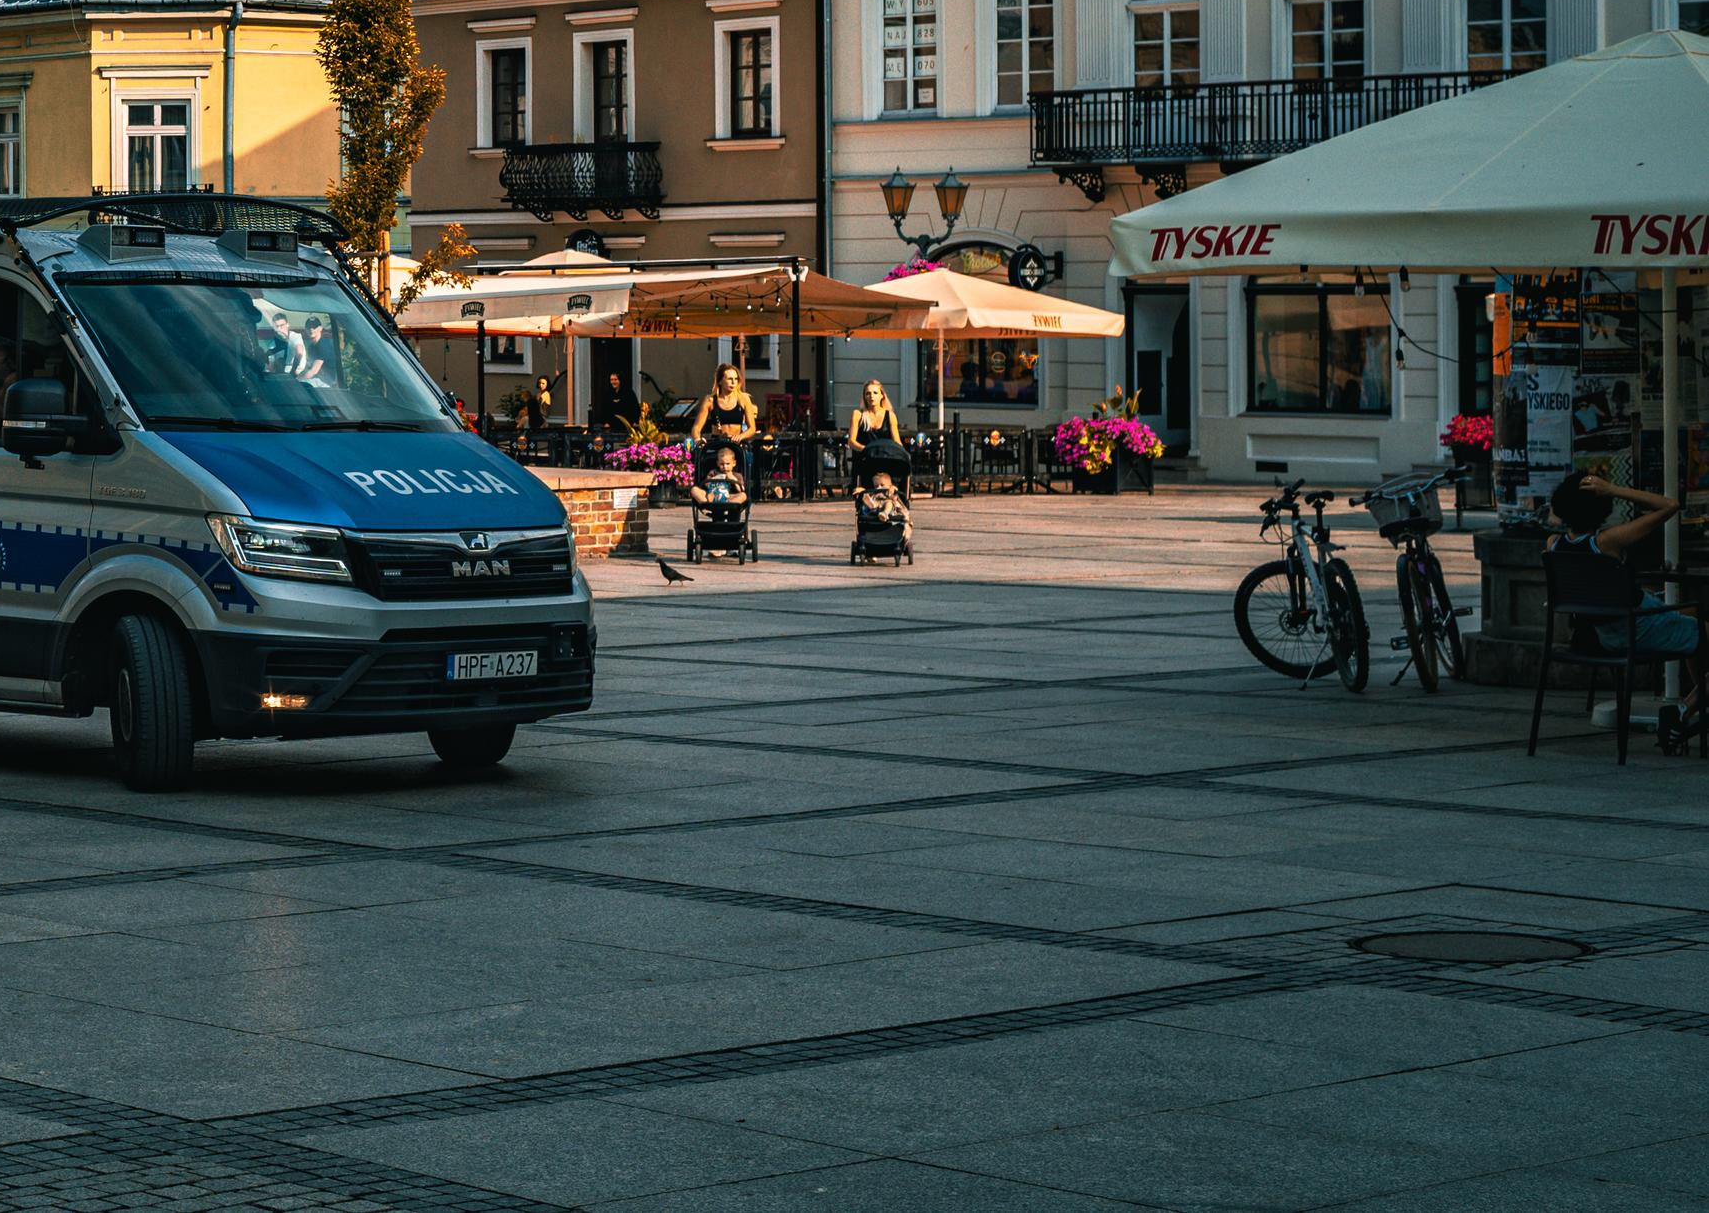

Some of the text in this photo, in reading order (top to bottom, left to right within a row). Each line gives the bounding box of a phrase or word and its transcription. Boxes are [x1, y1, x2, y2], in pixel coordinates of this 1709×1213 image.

[1150, 224, 1282, 262] TYSKIE
[343, 469, 519, 497] POLICJA
[451, 560, 511, 577] MAN
[458, 652, 534, 678] HPF A237
